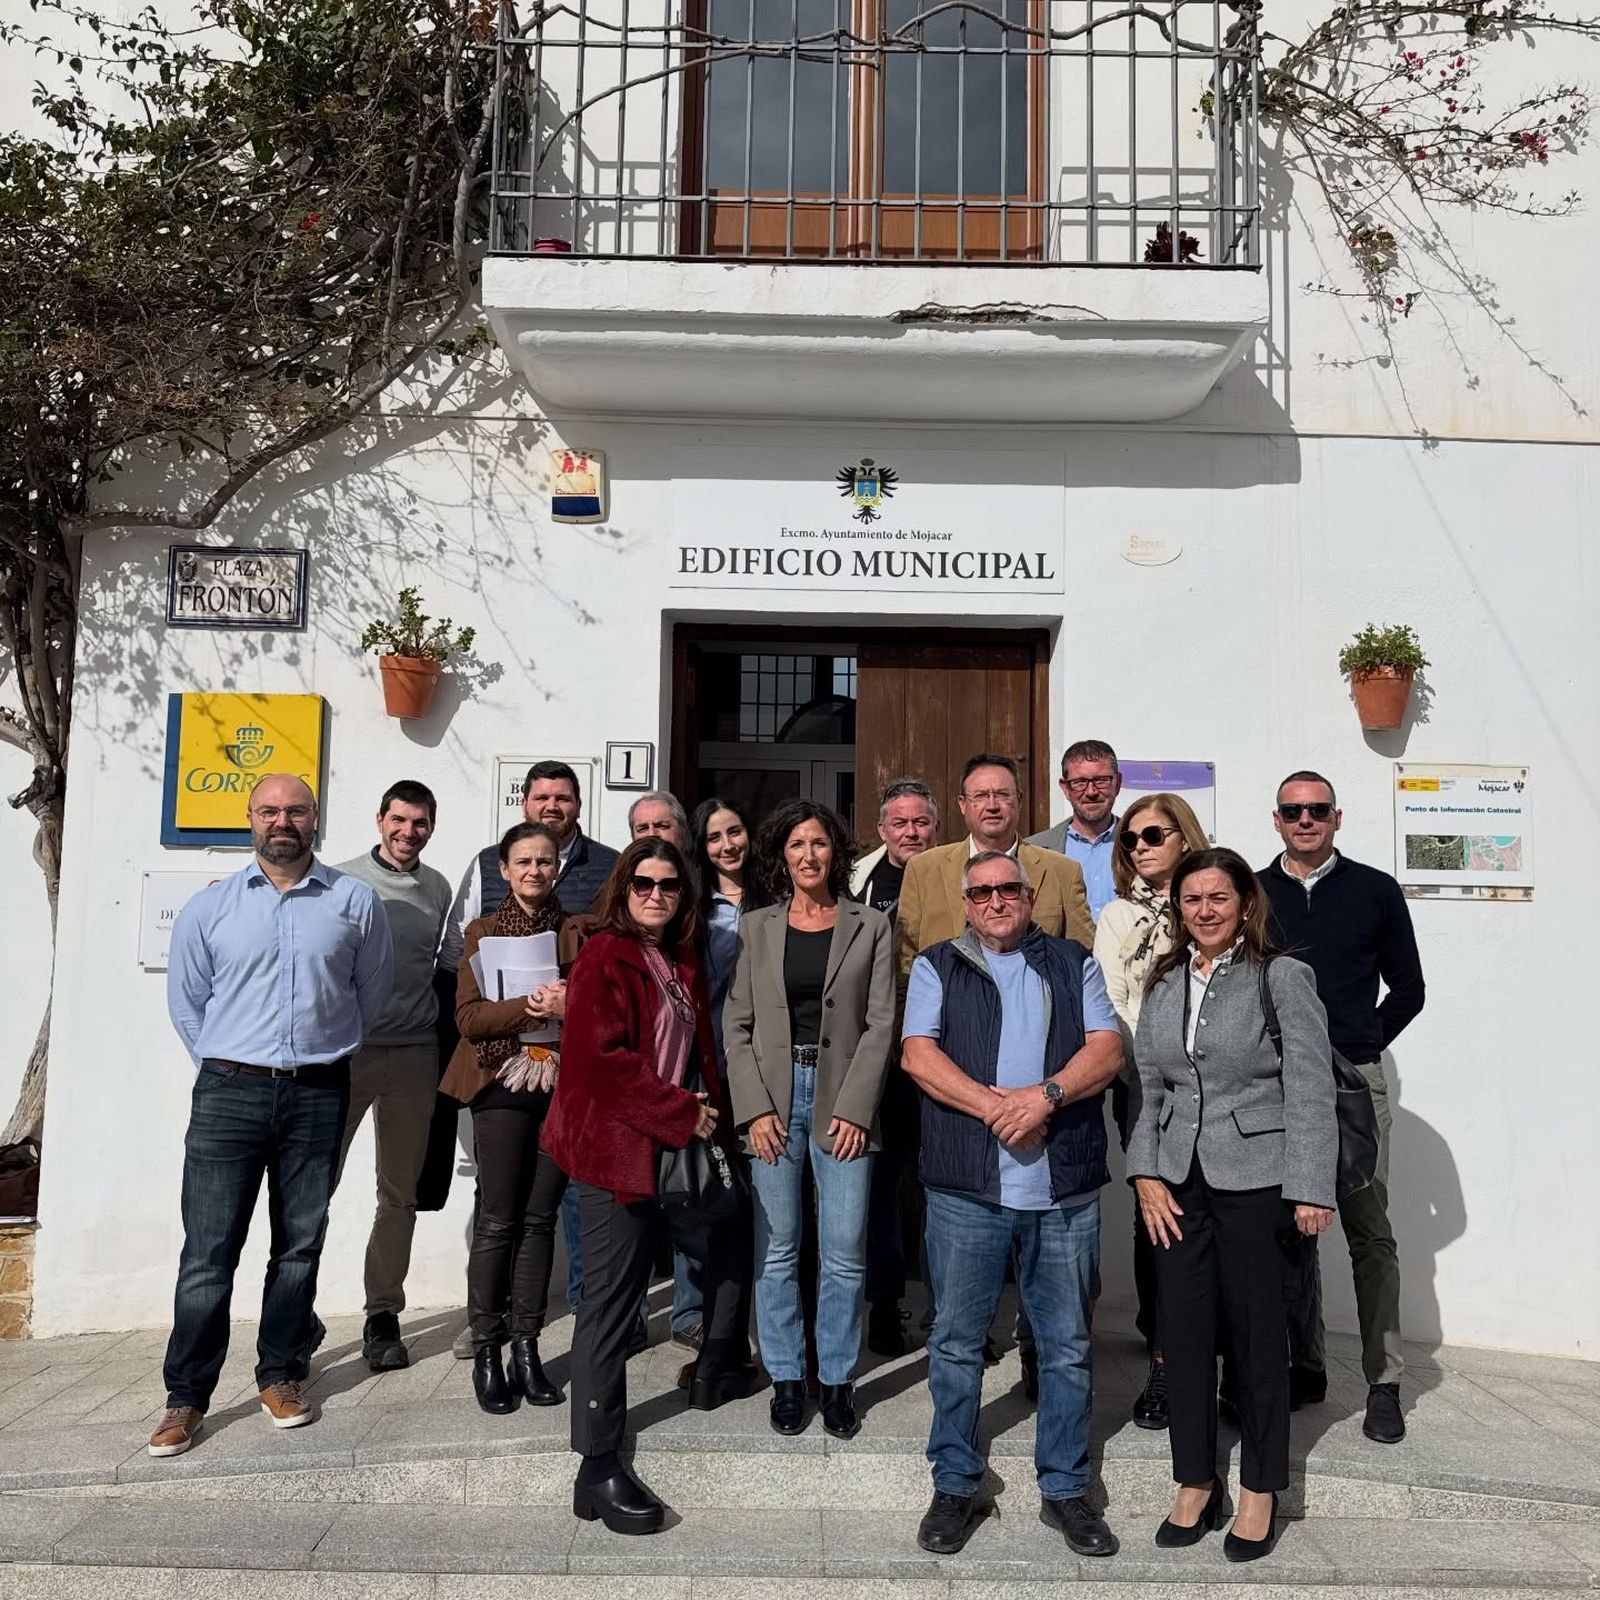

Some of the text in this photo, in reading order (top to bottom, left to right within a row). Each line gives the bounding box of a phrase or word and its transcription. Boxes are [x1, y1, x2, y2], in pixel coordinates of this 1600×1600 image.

[780, 527, 953, 542] Excmo. Ayuntamiento de Mojacar
[213, 559, 264, 577] PLAZA
[677, 546, 1056, 580] EDIFICIO MUNICIPAL
[178, 578, 293, 614] FRONTÓN
[621, 750, 635, 780] 1
[185, 767, 310, 793] CORR
